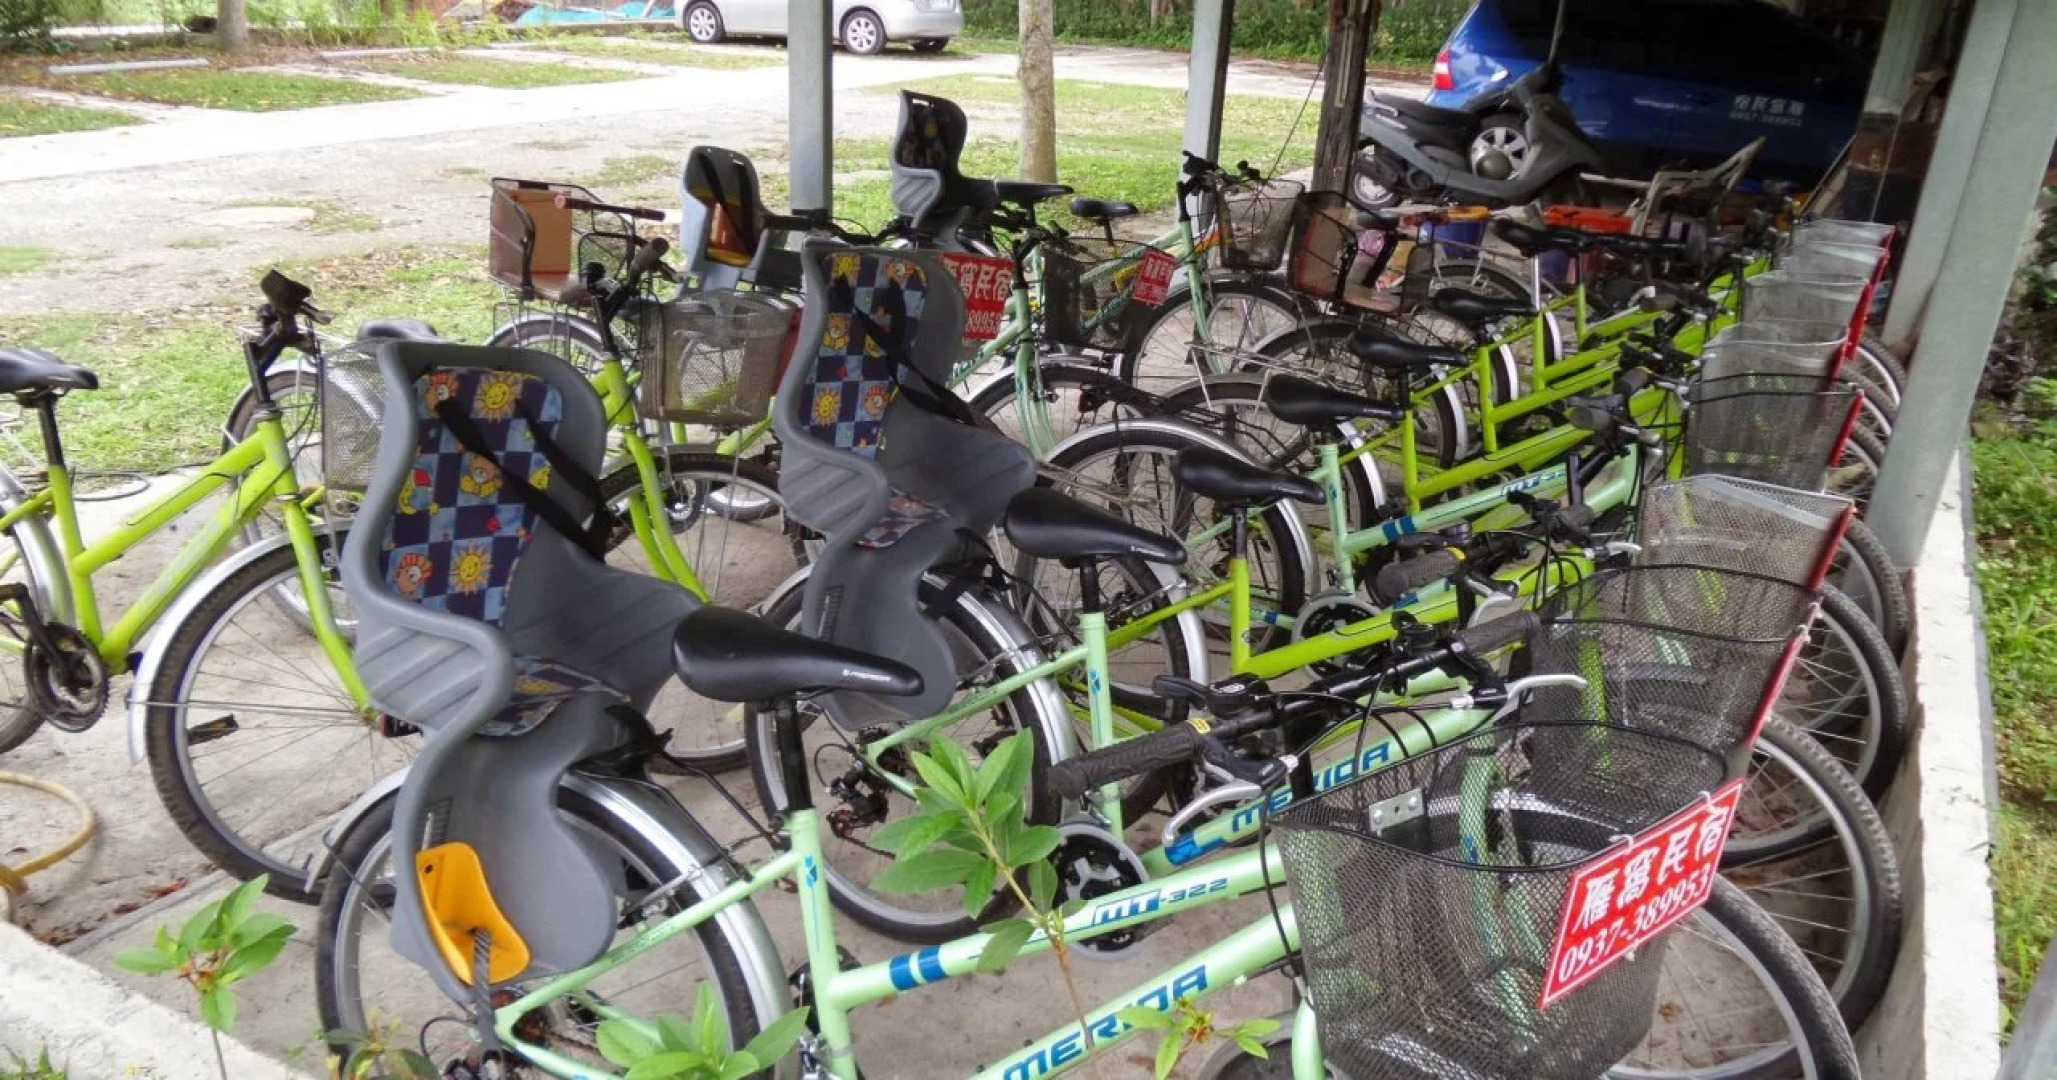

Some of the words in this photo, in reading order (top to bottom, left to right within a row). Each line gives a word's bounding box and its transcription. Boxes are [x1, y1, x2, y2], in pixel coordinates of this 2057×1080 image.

[1231, 741, 1390, 832] MEIDA
[1558, 862, 1711, 983] 0937-389953
[1571, 805, 1730, 934] 雁窩民宿
[1003, 964, 1208, 1080] MERDA
